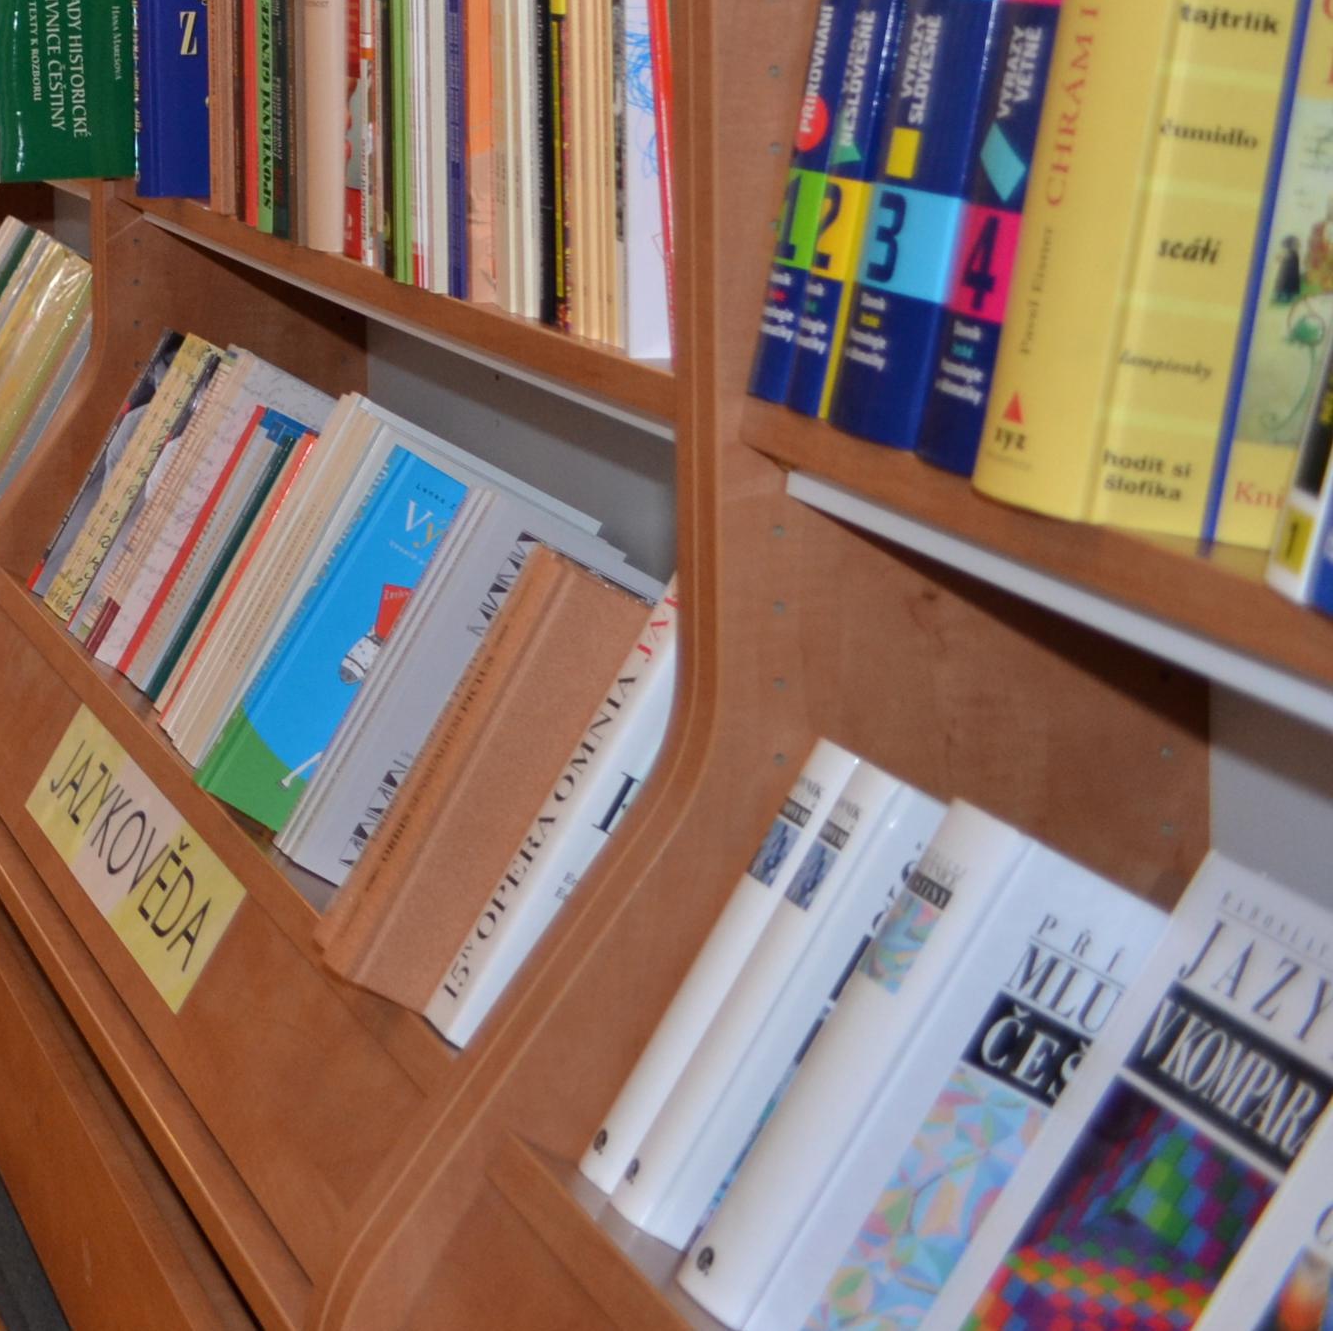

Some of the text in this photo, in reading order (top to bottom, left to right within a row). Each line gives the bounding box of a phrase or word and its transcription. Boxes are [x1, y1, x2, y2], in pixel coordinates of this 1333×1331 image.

[46, 57, 66, 131] ČEŠTINY
[68, 33, 92, 138] HISTORICKÉ
[258, 6, 272, 84] GENEZE
[909, 14, 942, 126] SLOVESNÉ
[1044, 35, 1096, 209] CHRÁM
[867, 189, 907, 283] 3
[960, 213, 997, 313] 4
[50, 739, 213, 972] JAZYKOVĚDA
[477, 815, 555, 941] OPERA
[553, 675, 636, 804] OMNIA
